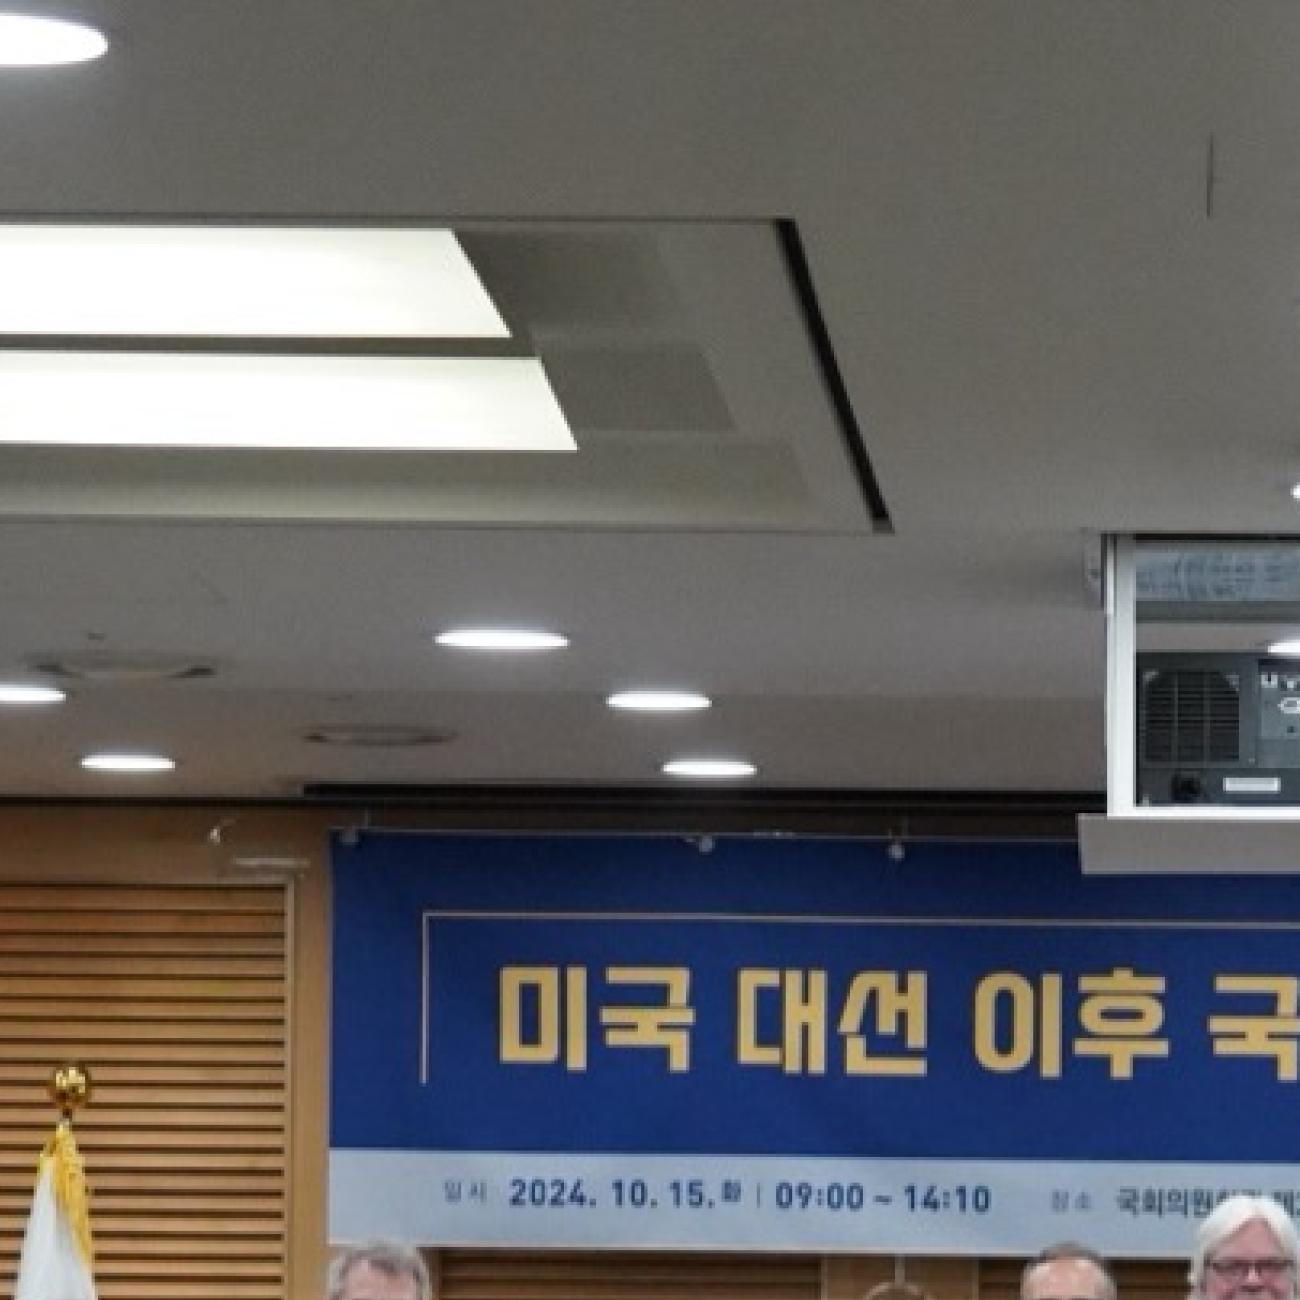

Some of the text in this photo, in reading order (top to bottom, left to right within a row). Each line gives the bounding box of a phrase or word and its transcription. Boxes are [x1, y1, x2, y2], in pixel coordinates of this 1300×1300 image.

[498, 963, 695, 1071] 미국
[736, 965, 928, 1077] 대선
[972, 966, 1170, 1080] 이후
[509, 1178, 597, 1208] 2024.
[611, 1178, 658, 1208] 10.
[775, 1181, 864, 1212] 09:00
[904, 1184, 993, 1214] 14:10
